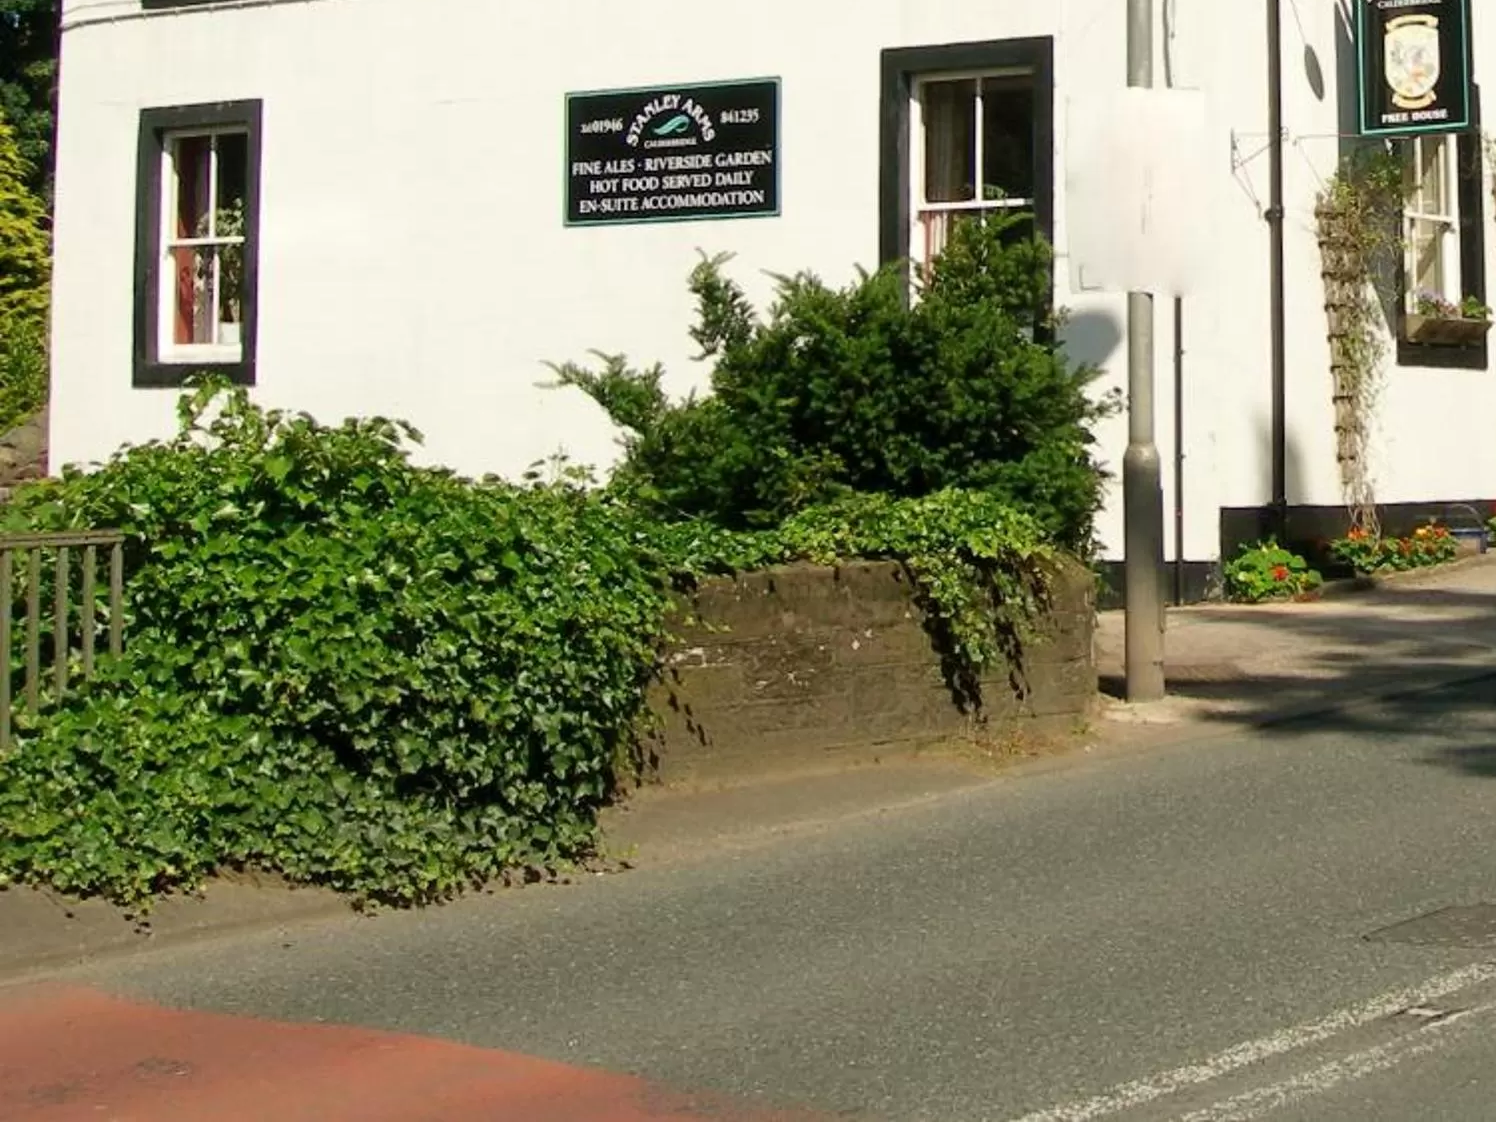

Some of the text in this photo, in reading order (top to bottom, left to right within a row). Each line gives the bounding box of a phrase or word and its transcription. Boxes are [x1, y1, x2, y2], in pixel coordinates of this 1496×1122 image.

[626, 94, 716, 147] STANLEY ARMS
[1381, 108, 1448, 123] FREE HOUSE
[572, 149, 773, 176] FINE ALES RIVERSIDE GARDEN
[590, 170, 754, 194] HOT FOOD SERVED DAILY
[579, 189, 765, 213] EN-SUITE ACCOMMODATION
